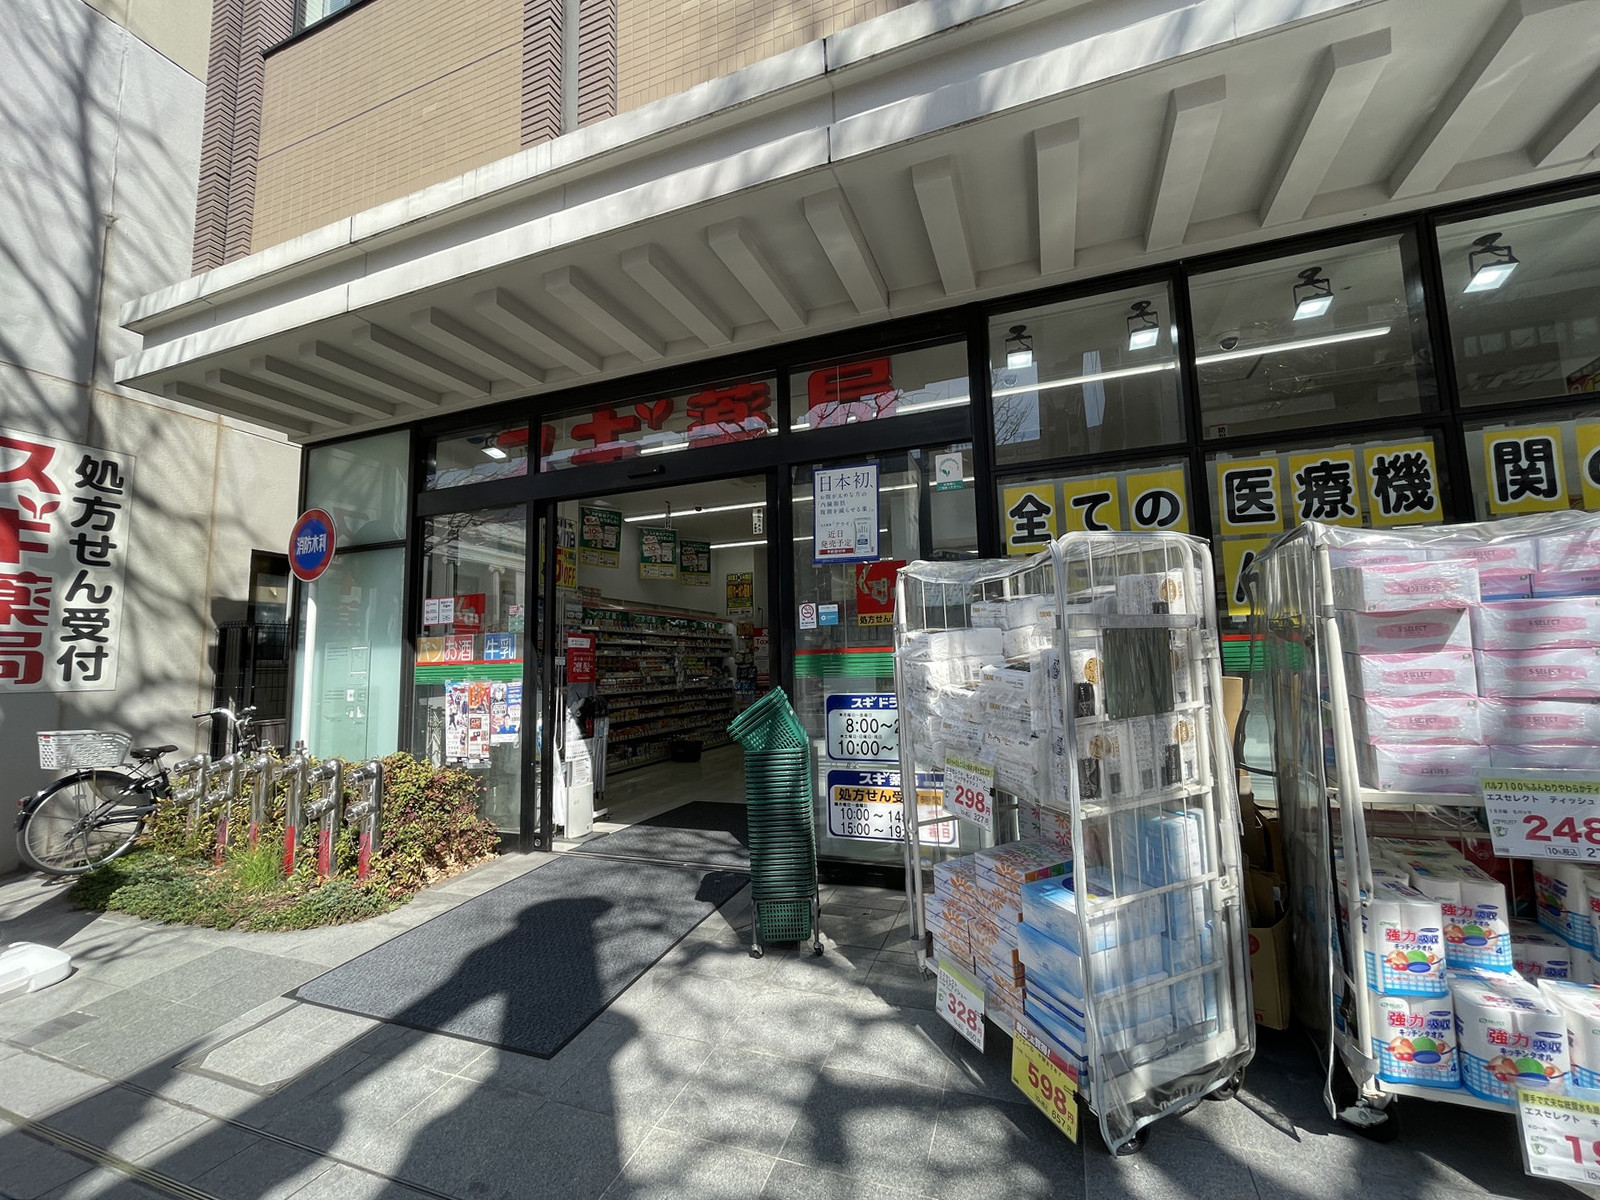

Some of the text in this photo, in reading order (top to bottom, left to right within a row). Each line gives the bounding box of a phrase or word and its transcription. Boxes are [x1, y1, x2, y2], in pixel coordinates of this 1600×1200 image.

[296, 534, 326, 555] 消防水利
[57, 454, 124, 683] 処方せん受付
[859, 614, 894, 625] 処方せん
[1533, 619, 1560, 627] SELECT
[445, 640, 471, 660] お酒
[486, 638, 514, 660] 牛乳
[1486, 793, 1596, 805] エスセレクト ティッシュ
[1522, 814, 1600, 846] 248
[1487, 1027, 1530, 1048] 強力
[1525, 1107, 1580, 1124] エスセレクト
